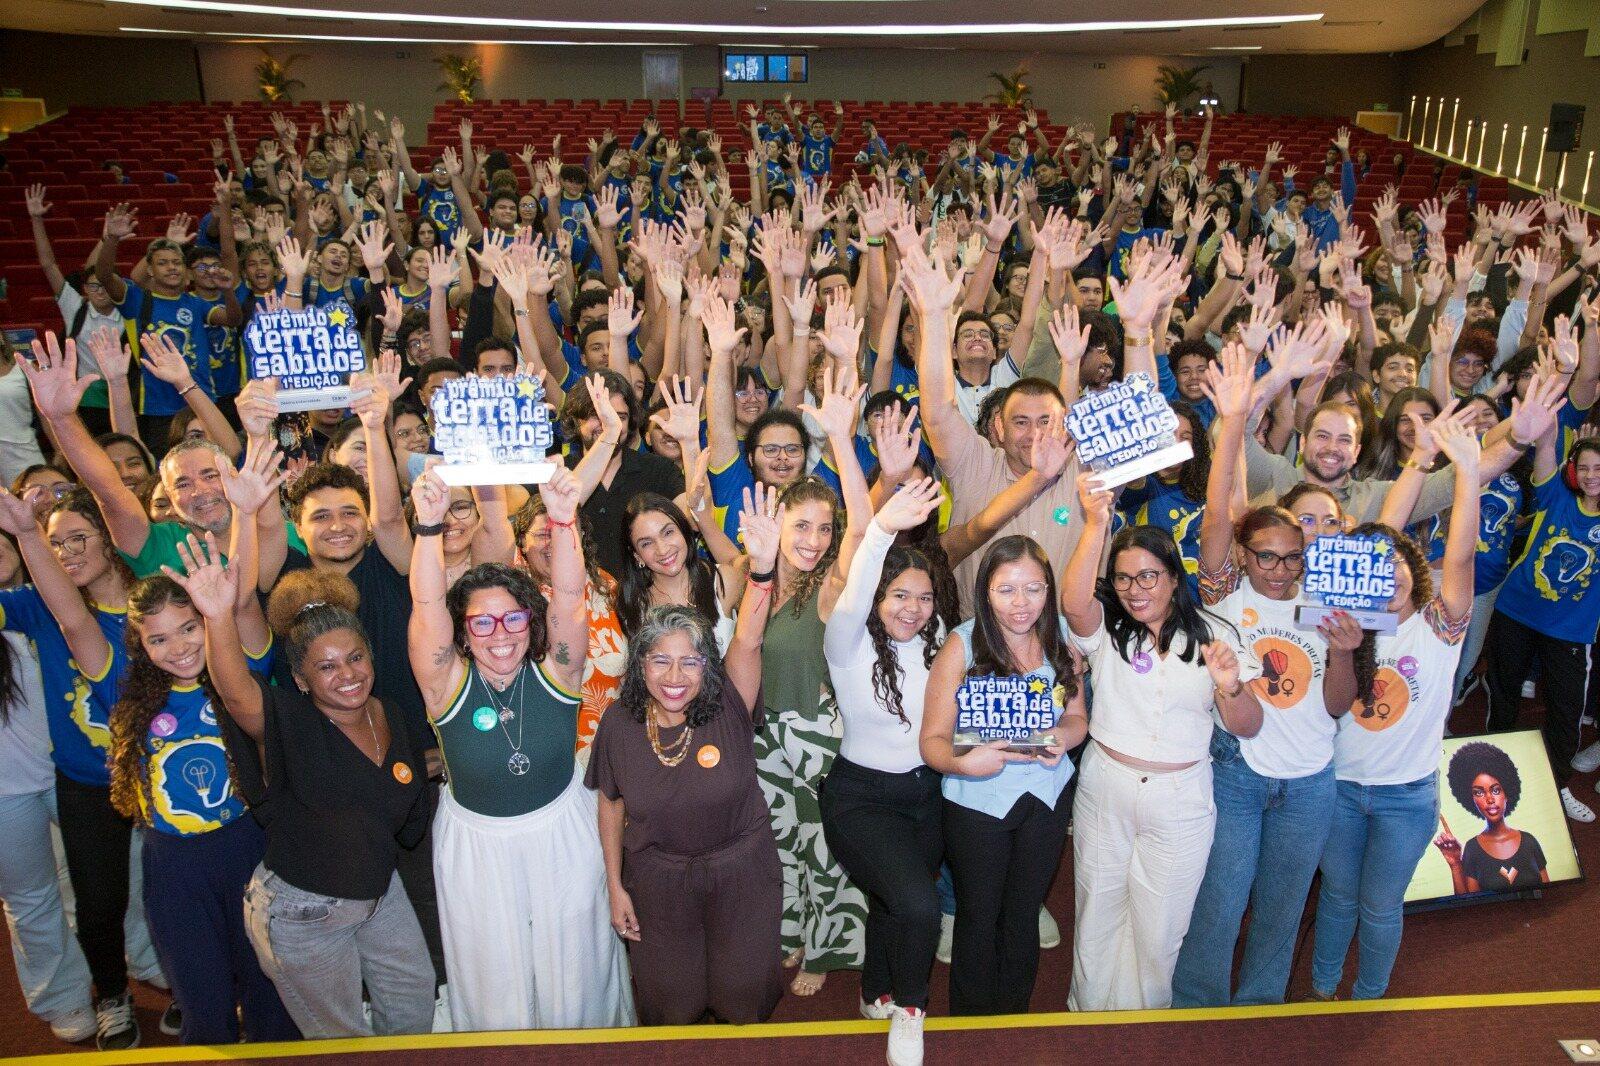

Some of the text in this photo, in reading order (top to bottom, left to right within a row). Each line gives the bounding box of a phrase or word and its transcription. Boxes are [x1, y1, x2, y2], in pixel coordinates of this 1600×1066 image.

[259, 307, 327, 332] prêmio
[248, 323, 359, 354] terra de
[254, 346, 364, 378] sabidos
[446, 376, 516, 401] prêmio
[434, 391, 546, 425] terra de
[1068, 393, 1169, 441] terra de
[1080, 410, 1176, 463] sabidos
[1318, 535, 1374, 554] prêmio
[1306, 545, 1395, 578] terra de
[1305, 567, 1396, 597] sabidos
[1302, 642, 1323, 679] PRETAS
[957, 688, 1052, 711] terra de
[969, 677, 1028, 694] prêmio
[959, 705, 1053, 729] sabidos
